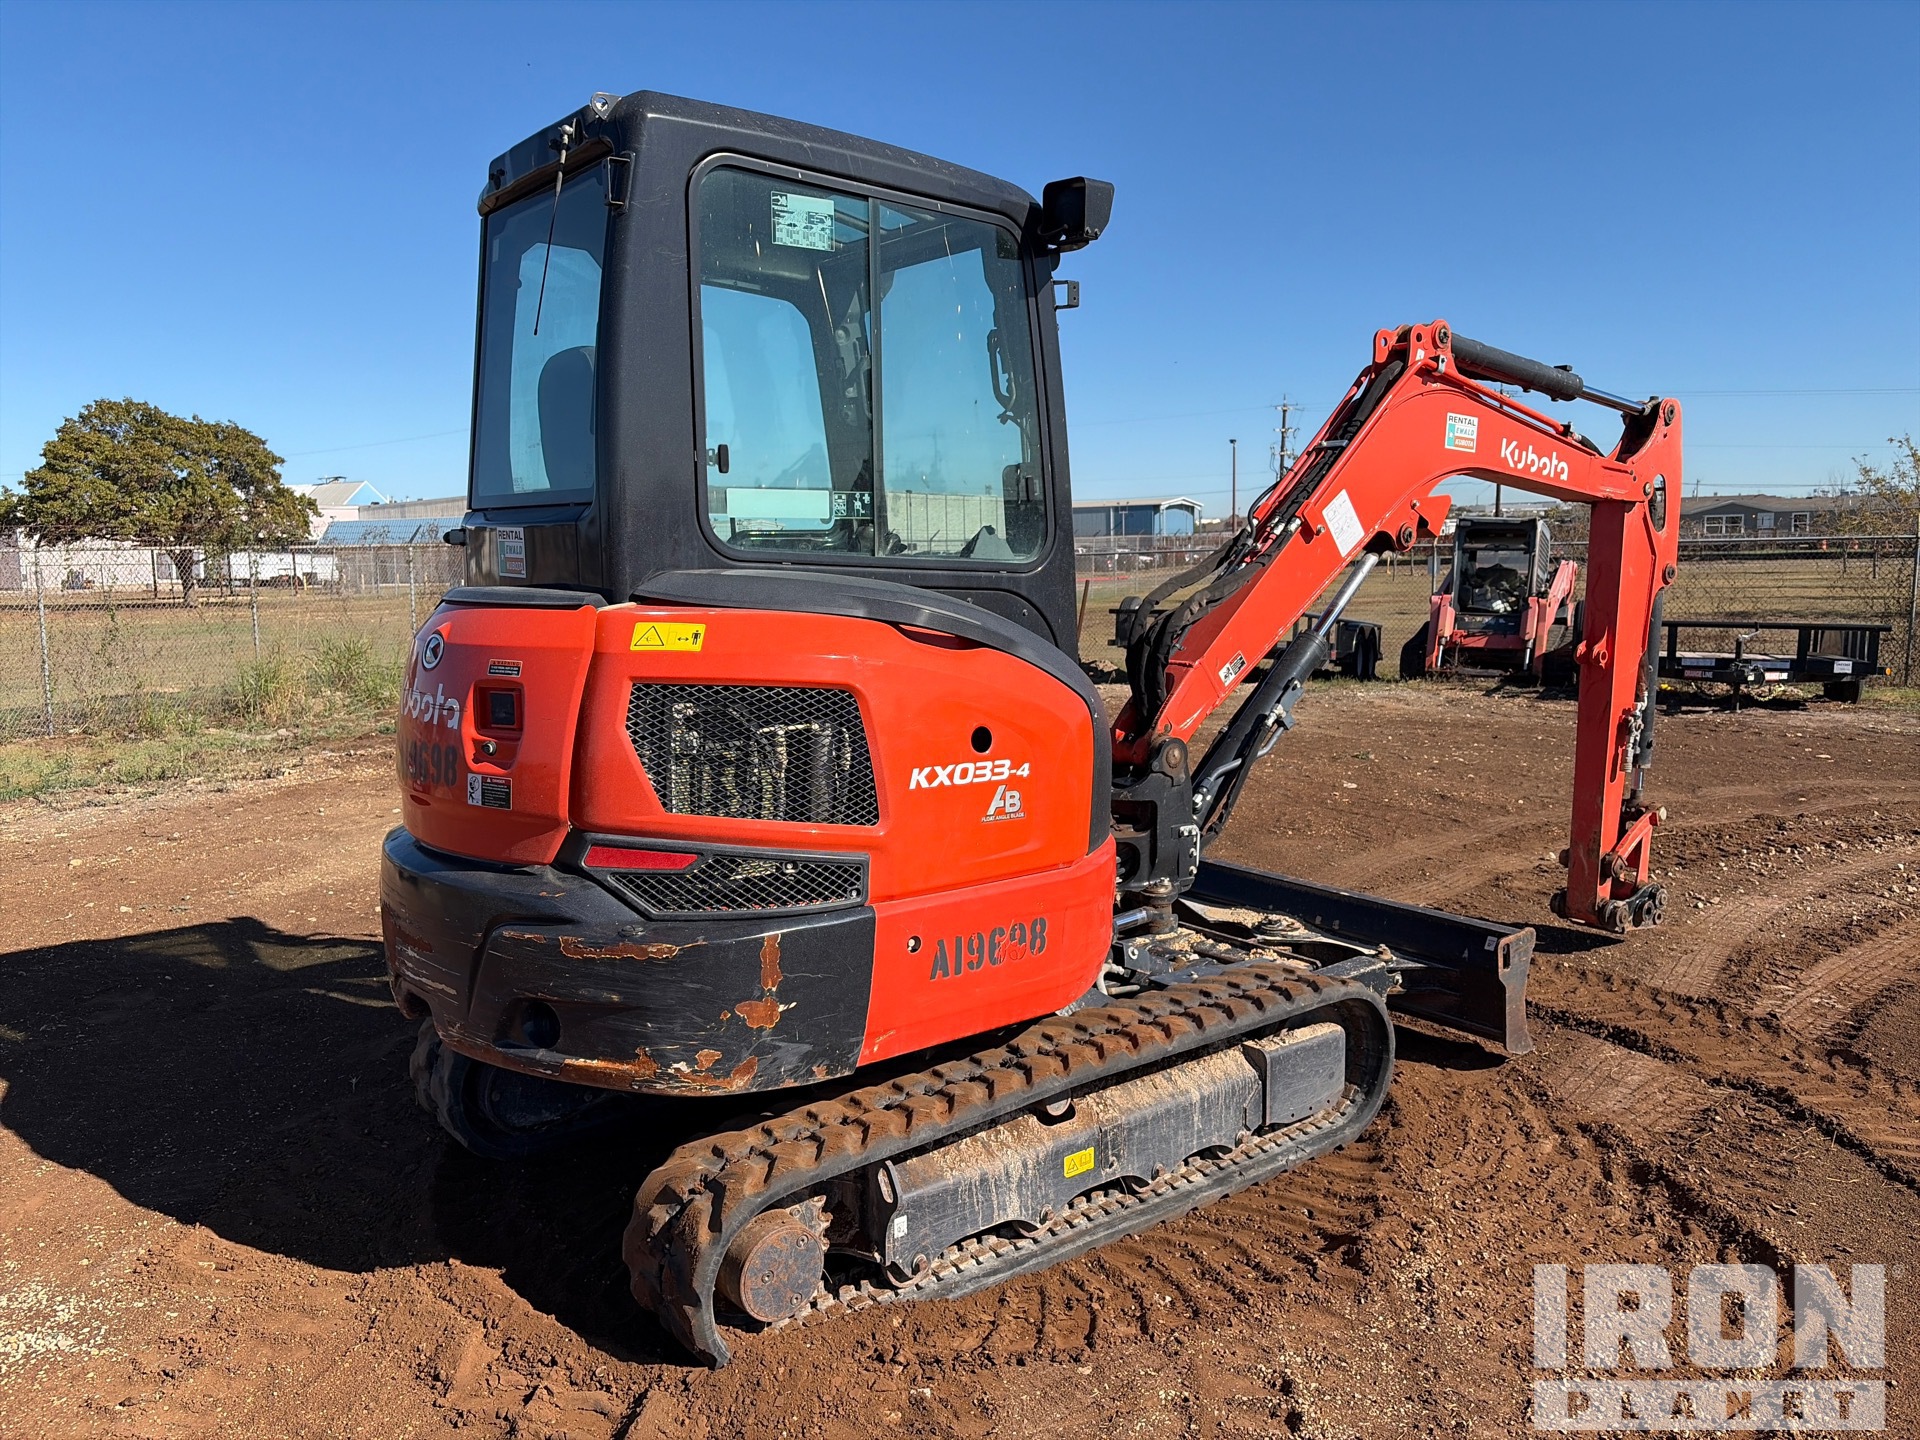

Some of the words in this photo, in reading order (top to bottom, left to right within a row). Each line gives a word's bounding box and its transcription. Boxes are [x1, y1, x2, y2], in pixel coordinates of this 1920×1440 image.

[1448, 415, 1476, 426] RENTAL
[1501, 437, 1568, 481] Kubota
[498, 530, 523, 541] RENTAL
[908, 759, 1030, 790] KX033-4
